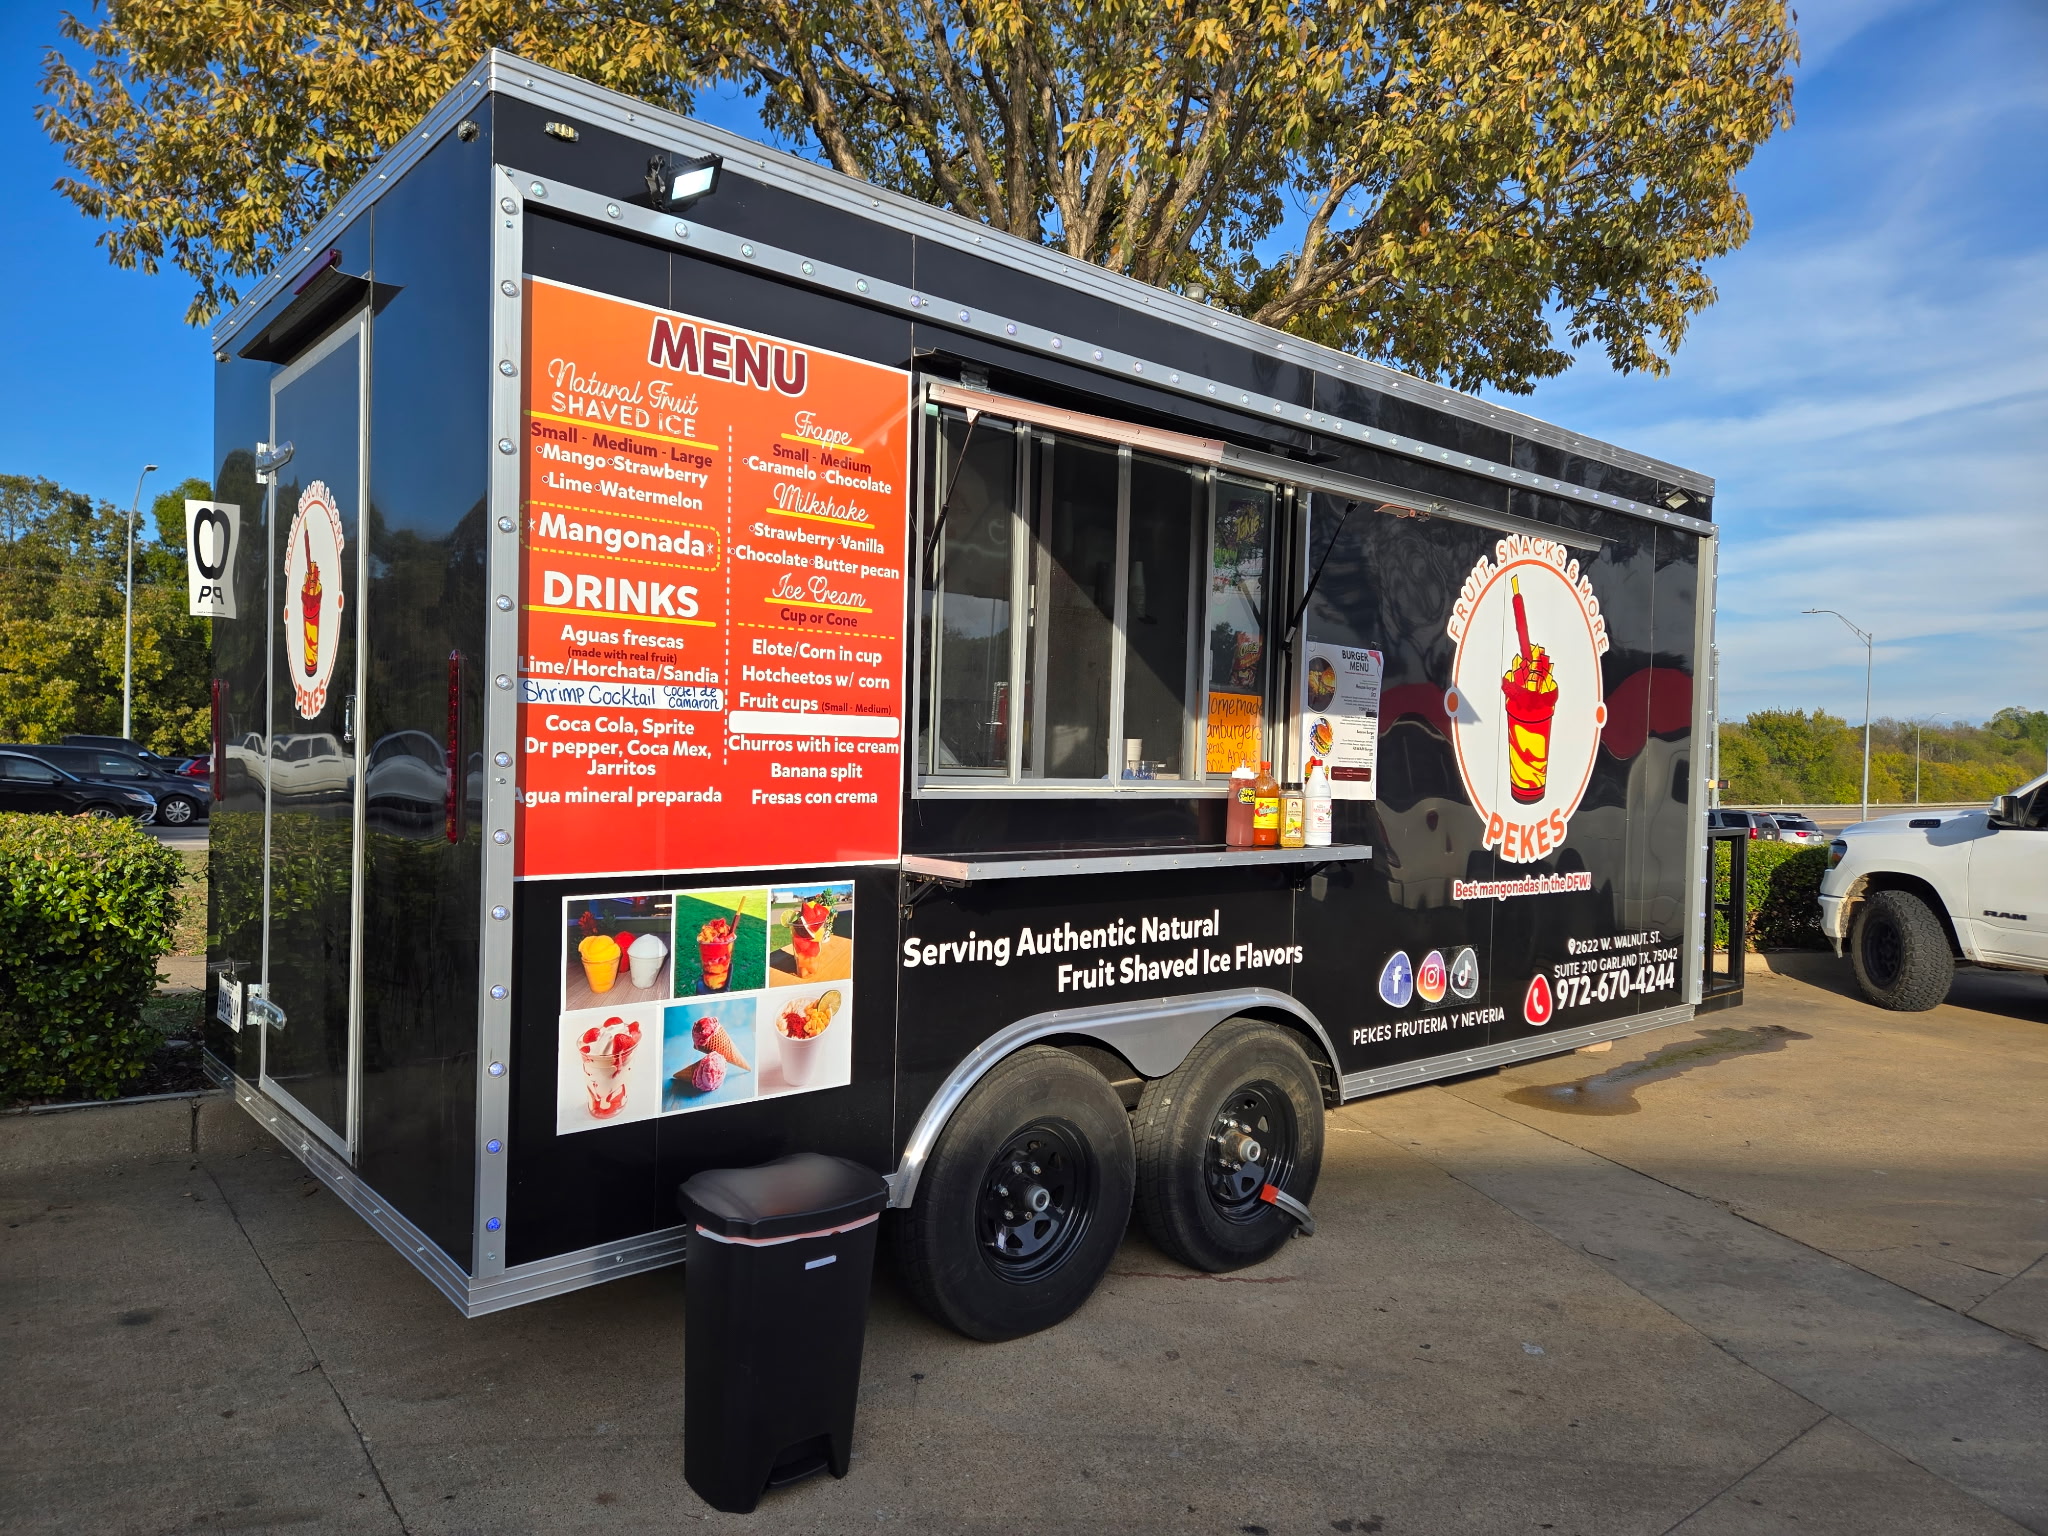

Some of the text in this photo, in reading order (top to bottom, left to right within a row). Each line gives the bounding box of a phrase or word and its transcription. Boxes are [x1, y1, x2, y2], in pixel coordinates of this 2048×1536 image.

[649, 316, 807, 396] MENU
[547, 357, 700, 416] Natural Fruit
[551, 392, 697, 438] SHAVED ICE
[794, 410, 853, 450] Frappe
[530, 421, 713, 470] Small Medium Large
[773, 443, 872, 474] Small Medium
[543, 443, 708, 489] Mango Strawberry
[748, 455, 893, 495] Caramelo Chocolate
[548, 471, 703, 511] Lime Watermelon
[773, 481, 869, 523] Milkshake
[538, 511, 706, 557] Mangonada
[754, 521, 885, 555] Strawberry Vanilla
[735, 544, 900, 580] Chocolate Butter pecan
[543, 570, 699, 619] DRINKS
[772, 572, 866, 607] Ice Cream
[1499, 537, 1565, 566] SNACKS
[1567, 563, 1579, 581] &
[1579, 583, 1608, 652] MORE
[780, 607, 858, 628] Cup or Cone
[560, 624, 684, 651] Aguas frescas
[752, 639, 883, 666] Elote/Corn in cup
[518, 655, 719, 683] Lime/Horchata/Sandia
[567, 647, 678, 665] (made with real fruit)
[1342, 650, 1369, 661] BURGER
[1350, 661, 1369, 672] MENU
[700, 687, 717, 698] de
[742, 666, 890, 690] Hotcheetos w/ corn
[297, 680, 326, 715] PEKES
[588, 684, 655, 706] Cocktail
[739, 692, 892, 716] Fruit cups (Small Medium)
[545, 714, 695, 738] Coca Cola, Sprite
[525, 736, 712, 760] Dr pepper, Coca Mex,
[728, 735, 899, 756] Churros with ice cream
[587, 759, 656, 777] Jarritos
[771, 764, 863, 782] Banana split
[565, 788, 633, 804] mineral
[636, 788, 722, 807] preparada
[752, 789, 878, 805] Fresas con crema
[1486, 811, 1566, 858] PEKES
[1455, 873, 1591, 898] Best mangonadas in the DFW!
[1984, 910, 2027, 920] RAM
[903, 909, 1220, 966] Serving Authentic Natural
[1575, 939, 1599, 955] 2622
[1600, 938, 1612, 952] W.
[1649, 931, 1661, 946] ST.
[1058, 942, 1303, 992] Fruit Shaved Ice Flavors
[1554, 947, 1678, 979] SUITE 210 GARLAND TX. 75042
[1557, 962, 1675, 1010] 972-670-4244
[1353, 1007, 1505, 1046] PEKES FRUTERIA Y NEVERIA
